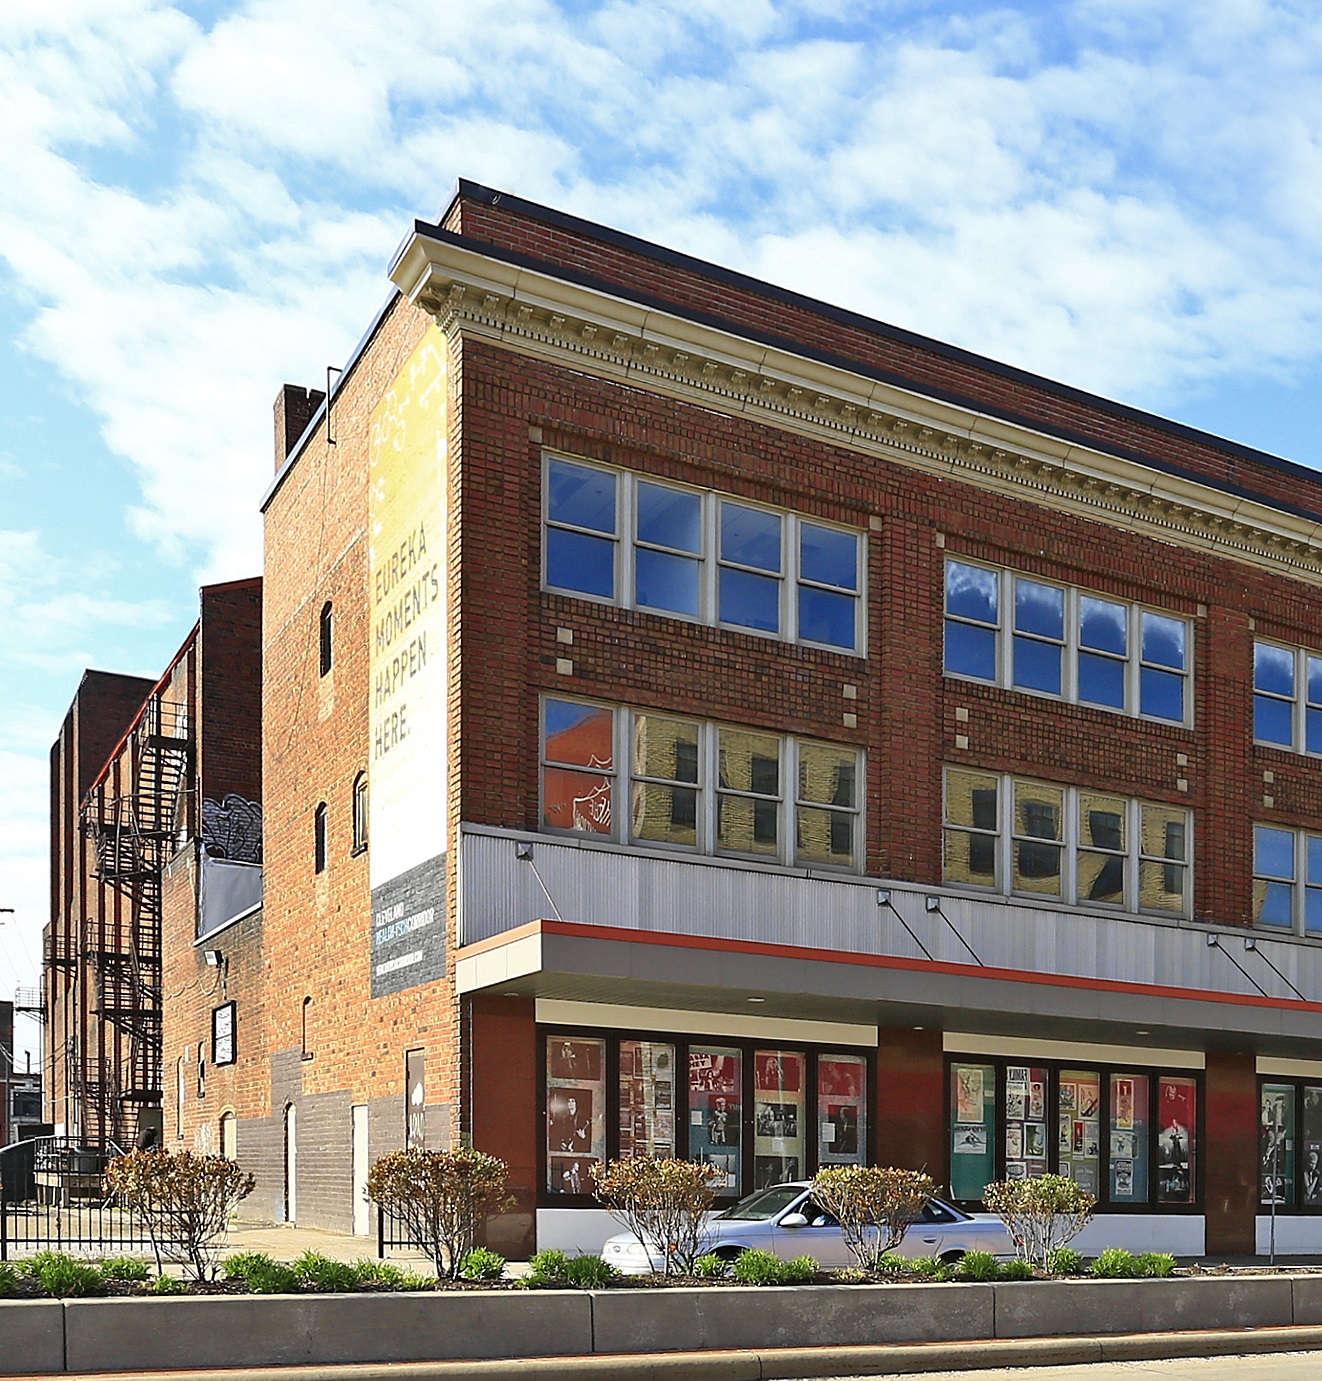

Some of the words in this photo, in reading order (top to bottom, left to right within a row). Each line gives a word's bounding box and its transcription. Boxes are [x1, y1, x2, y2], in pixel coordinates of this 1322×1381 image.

[375, 521, 427, 605] EUREKA
[375, 563, 439, 657] MOMENTS
[375, 631, 427, 708] HAPPEN
[375, 703, 411, 760] HERE.
